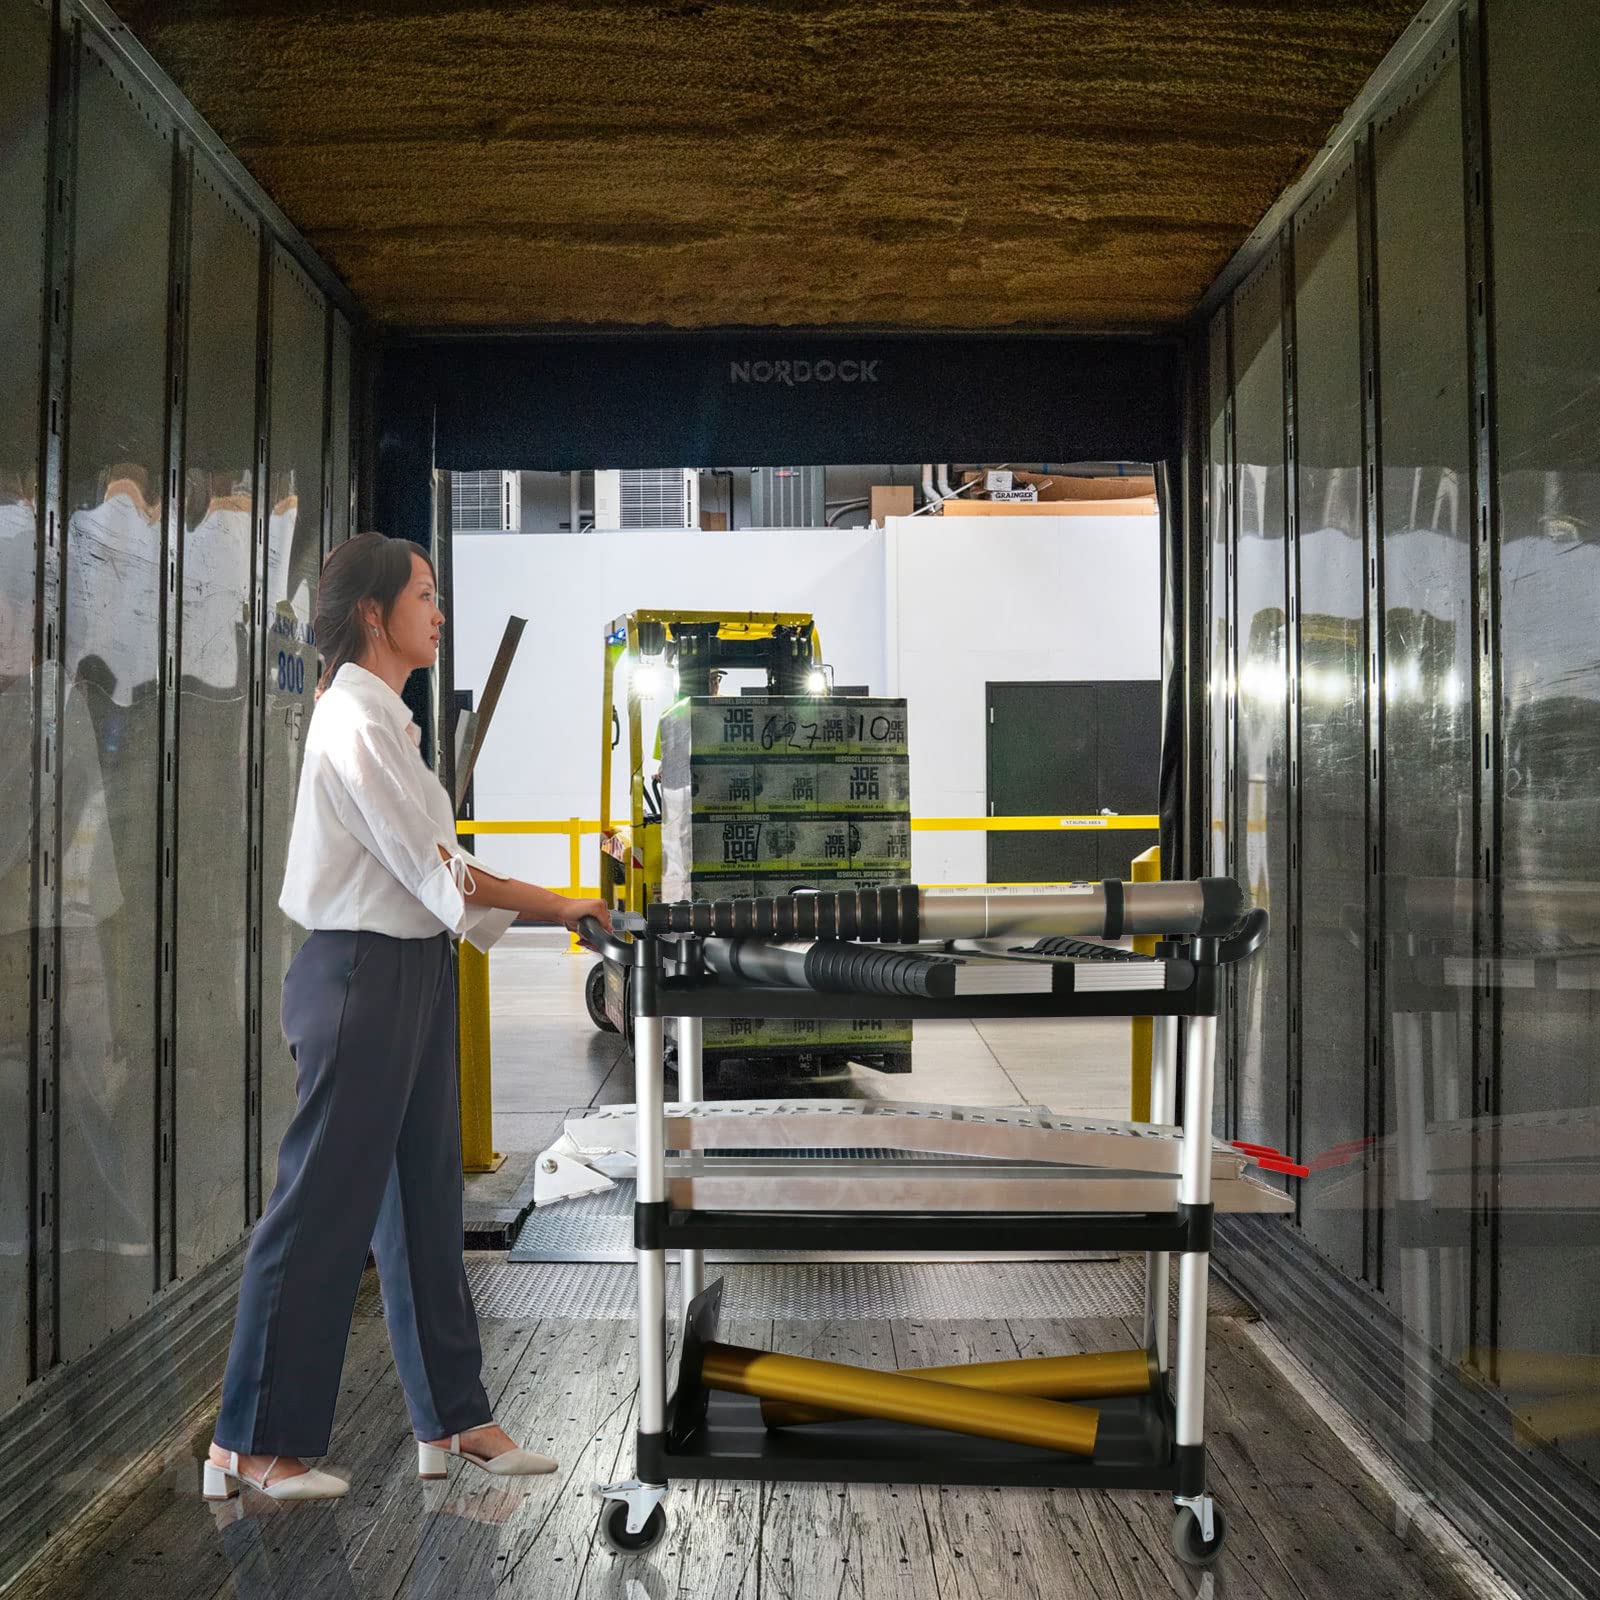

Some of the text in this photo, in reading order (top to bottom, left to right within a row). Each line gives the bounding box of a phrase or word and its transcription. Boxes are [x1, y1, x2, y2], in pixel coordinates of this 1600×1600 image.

[730, 359, 879, 386] NORDOCK
[278, 650, 304, 694] 800
[723, 708, 754, 724] JOE
[823, 719, 843, 730] JOE
[859, 715, 890, 741] 10
[723, 724, 755, 743] IPA
[823, 730, 844, 743] IPA
[850, 766, 880, 781] JOE
[729, 777, 750, 789] JOE
[792, 777, 814, 788] JOE
[729, 788, 750, 801] IPA
[792, 788, 813, 801] IPA
[850, 781, 880, 800] IPA
[725, 825, 755, 840] JOE
[825, 834, 845, 845] JOE
[887, 834, 908, 845] JOE
[724, 840, 756, 860] IPA
[825, 845, 846, 858] IPA
[887, 845, 908, 858] IPA
